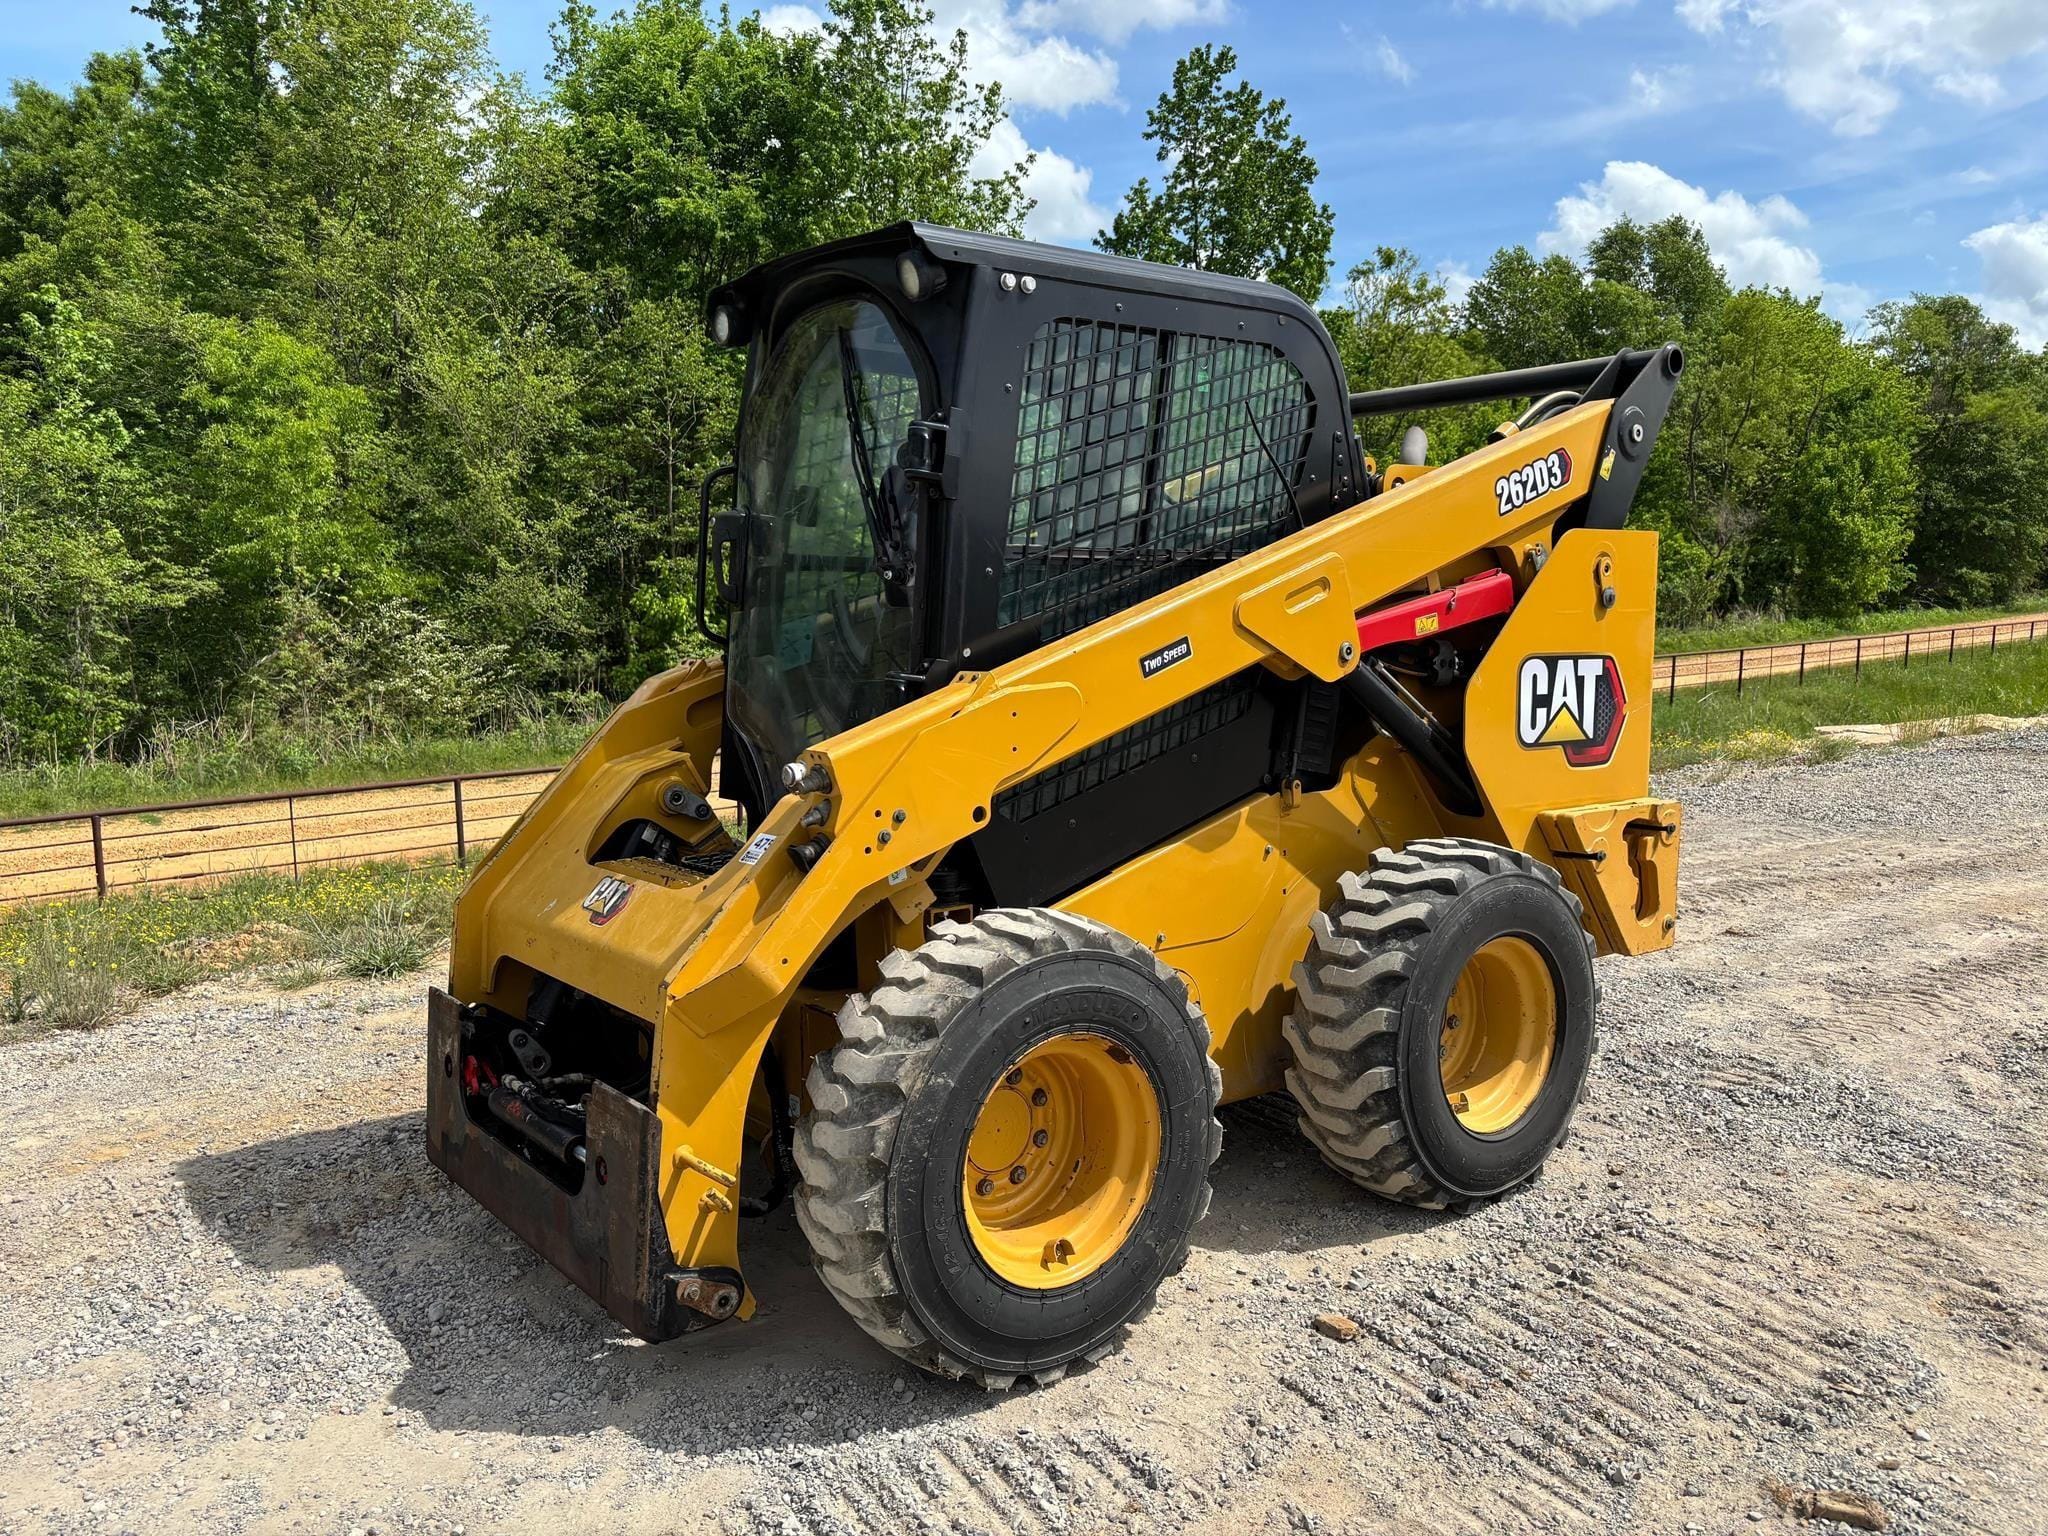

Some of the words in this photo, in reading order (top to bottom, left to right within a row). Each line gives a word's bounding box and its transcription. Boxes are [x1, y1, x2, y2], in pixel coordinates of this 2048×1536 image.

[1496, 453, 1562, 514] 262D3
[1519, 658, 1604, 744] CAT
[583, 877, 630, 916] CAT
